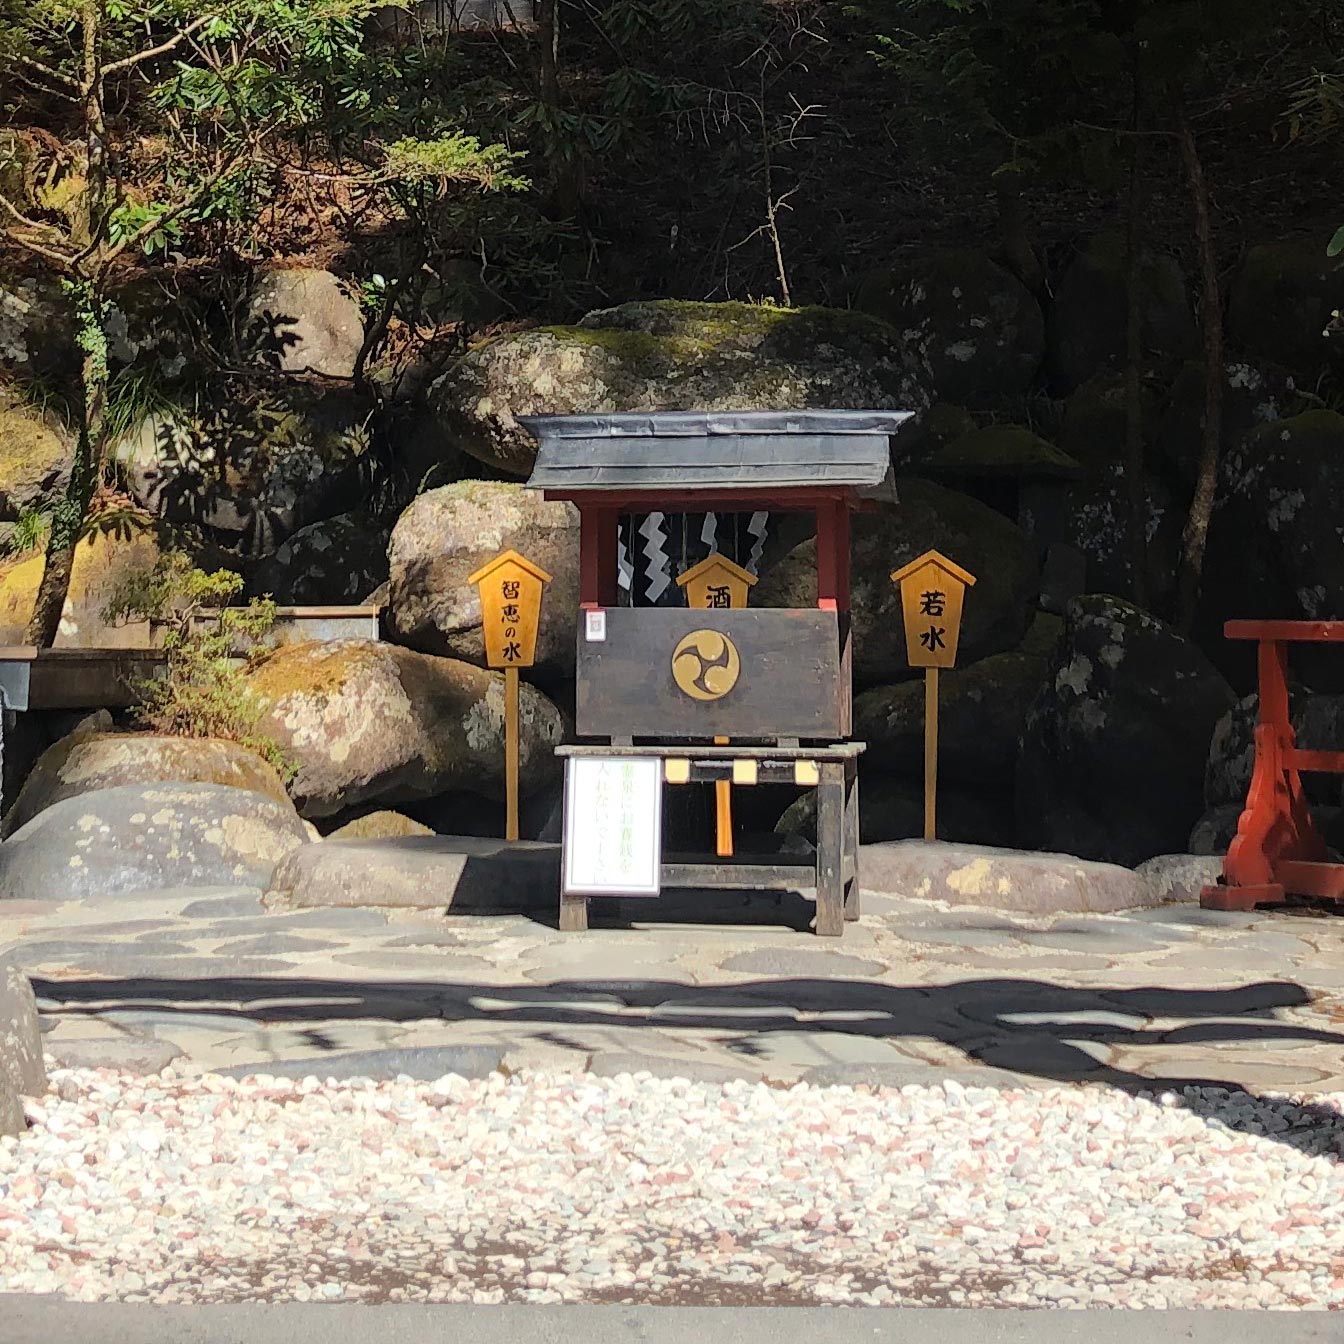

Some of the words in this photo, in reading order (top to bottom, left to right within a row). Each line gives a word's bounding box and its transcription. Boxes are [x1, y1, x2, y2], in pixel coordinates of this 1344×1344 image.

[500, 580, 522, 663] 智恵の水
[919, 589, 946, 653] 若水
